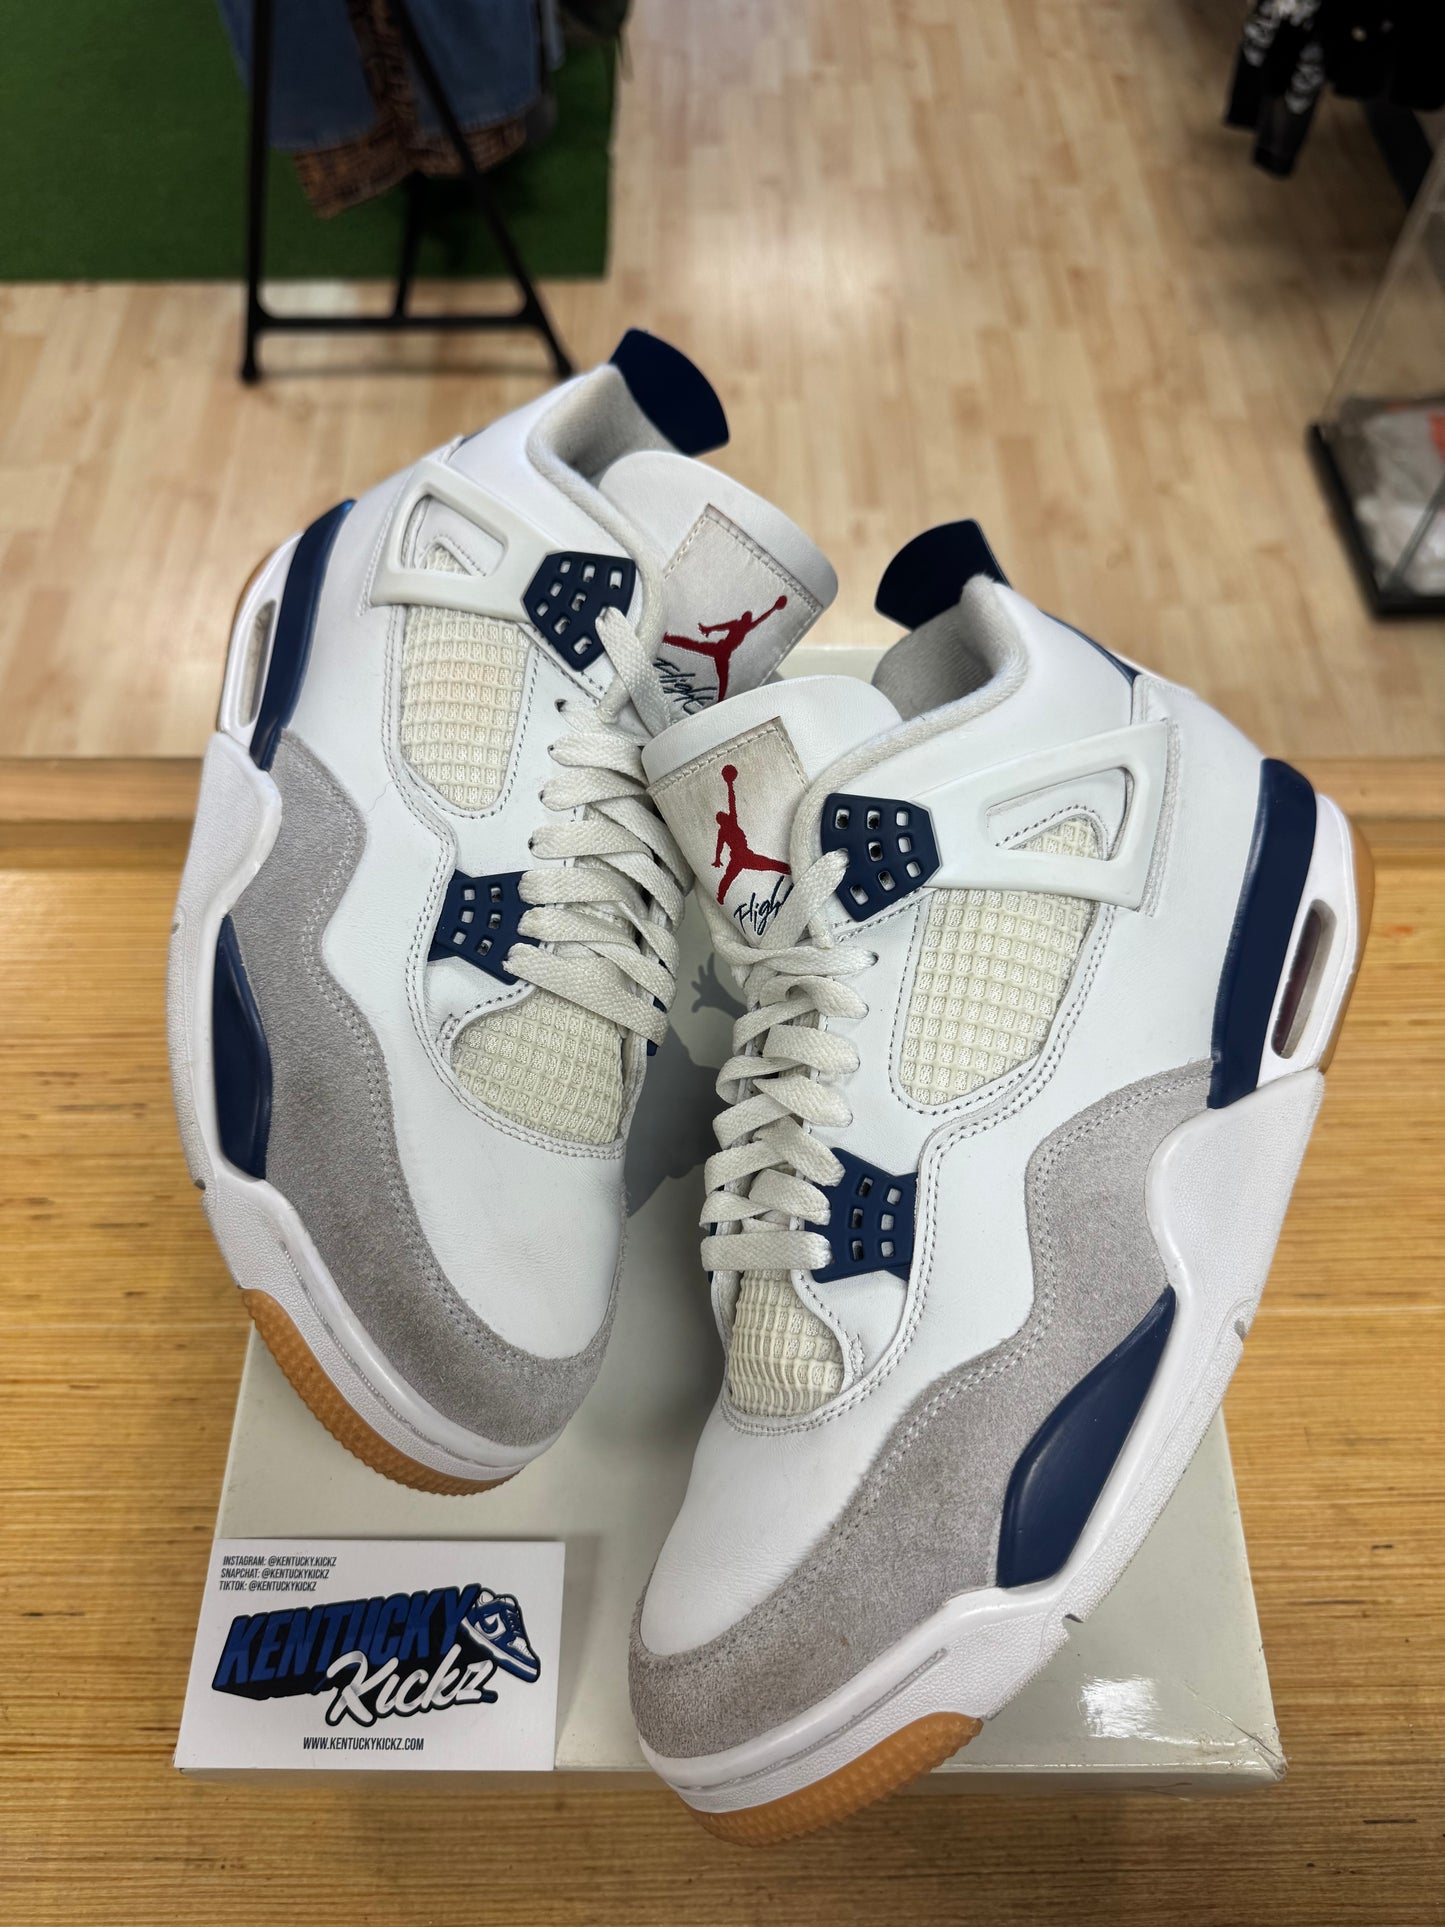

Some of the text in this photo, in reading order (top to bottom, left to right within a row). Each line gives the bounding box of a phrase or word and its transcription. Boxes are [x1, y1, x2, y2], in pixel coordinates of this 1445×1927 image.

[222, 1555, 338, 1567] INSTAGRAM: @KENTUCKY.KICKZ
[221, 1567, 330, 1579] SNAPCHAT: @KENTUCKYKICKZ
[219, 1580, 318, 1592] TIKTOK: @KENTUCKYKICKZ
[213, 1584, 482, 1690] KENTUCKY
[326, 1643, 495, 1724] Kickz
[302, 1736, 425, 1751] WWW.KENTUCKYKICKZ.COM
